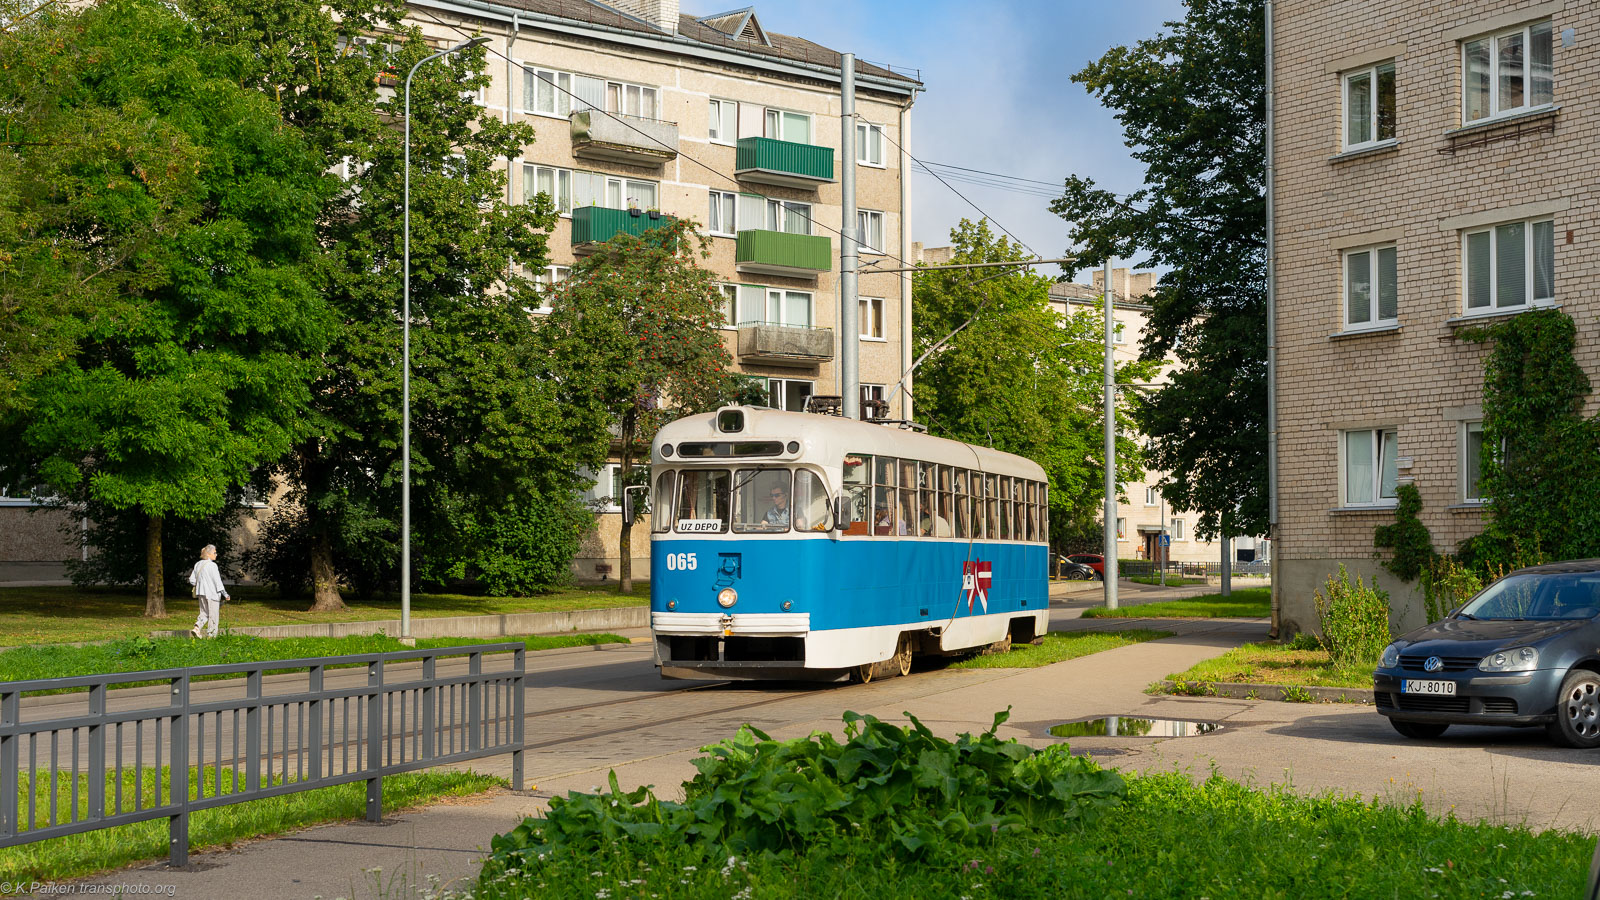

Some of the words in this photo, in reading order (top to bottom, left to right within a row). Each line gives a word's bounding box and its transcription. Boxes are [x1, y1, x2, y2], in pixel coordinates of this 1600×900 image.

[680, 523, 693, 531] UZ
[695, 523, 718, 531] DEPO
[666, 552, 698, 571] 065
[1407, 680, 1454, 694] KJ-8010
